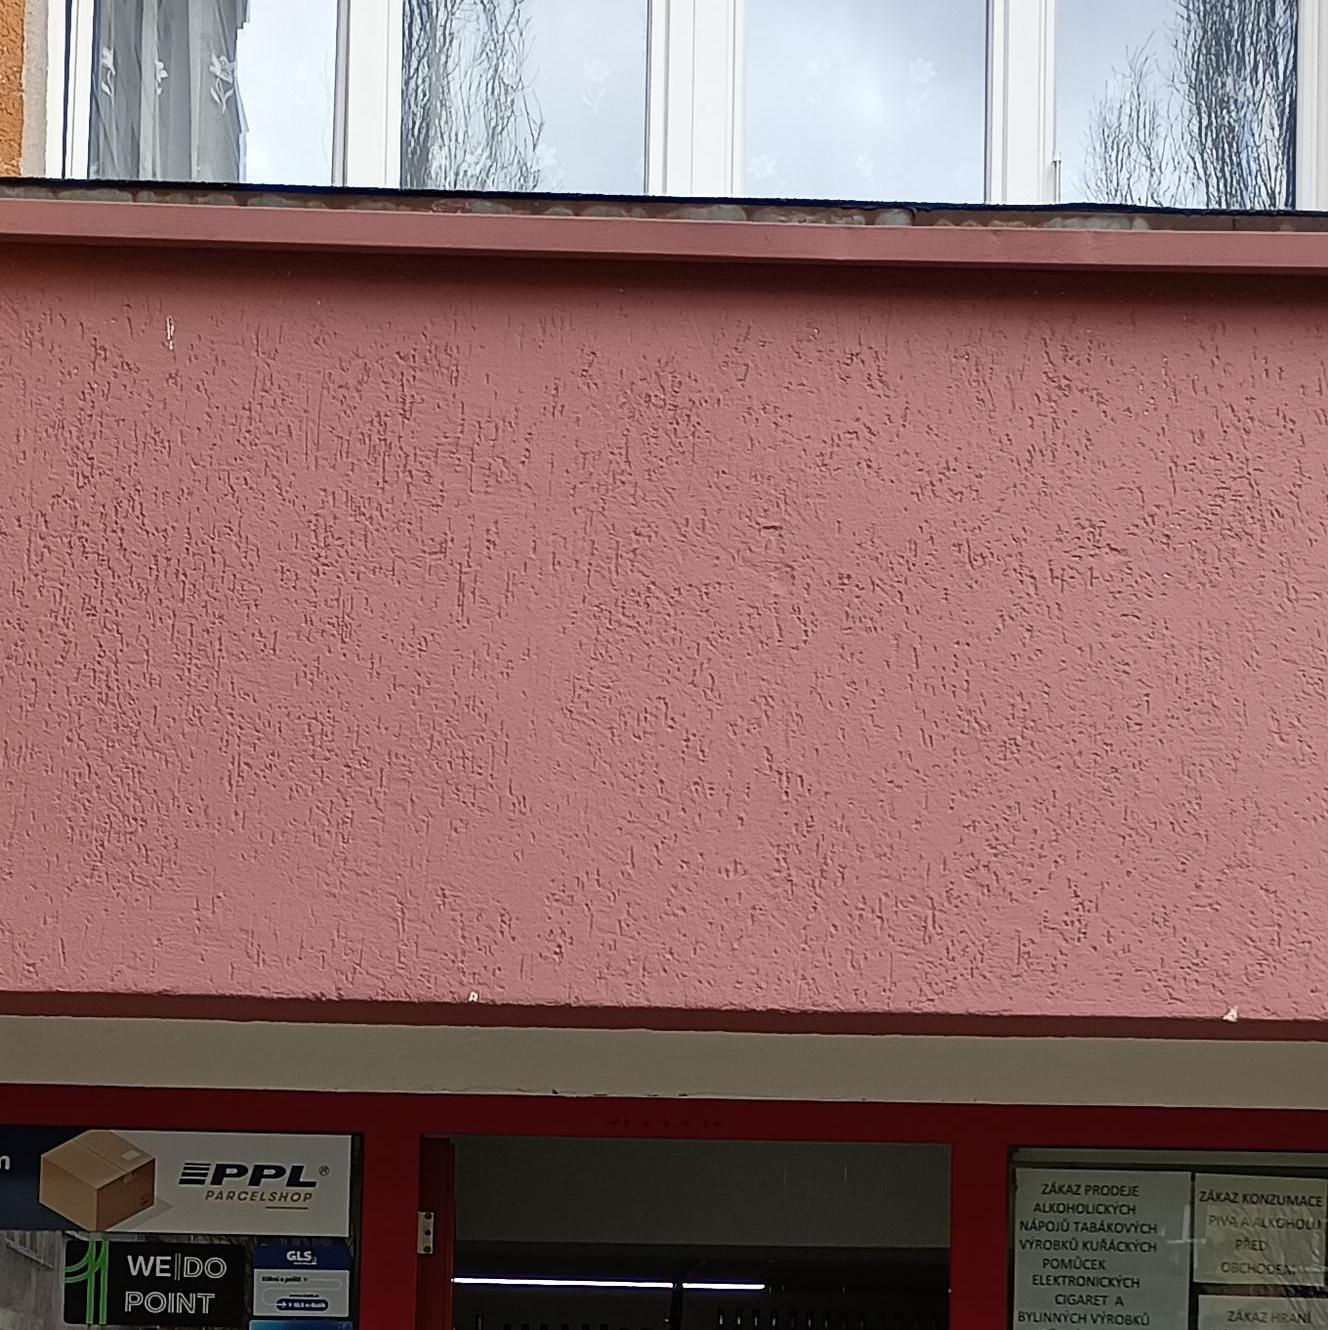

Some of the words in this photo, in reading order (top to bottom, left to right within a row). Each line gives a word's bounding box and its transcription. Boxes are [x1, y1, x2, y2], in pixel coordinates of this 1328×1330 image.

[210, 1163, 317, 1188] PPL
[205, 1190, 312, 1202] PARCELSHOP
[1042, 1181, 1081, 1195] ZÁKAZ
[1084, 1184, 1140, 1197] PRODEJE
[1199, 1189, 1239, 1204] ZÁKAZ
[1242, 1192, 1323, 1207] KONZUMACE
[1034, 1201, 1136, 1215] ALKOHOLICKÝCH
[1020, 1218, 1069, 1232] NÁPOJŮ
[1073, 1220, 1157, 1234] TABÁKOVÝCH
[1019, 1236, 1078, 1251] VÝROBKŮ
[1083, 1238, 1157, 1252] KUŘÁCKÝCH
[286, 1250, 313, 1261] GLS
[1042, 1256, 1105, 1270] POMŮCEK
[1032, 1274, 1140, 1288] ELEKTRONICKÝCH
[124, 1290, 216, 1314] POINT
[1055, 1294, 1108, 1306] CIGARET
[1115, 1296, 1124, 1306] A
[1018, 1310, 1087, 1324] BYLINNÝCH
[1091, 1311, 1150, 1326] VÝROBKŮ
[1228, 1309, 1268, 1323] ZÁKAZ
